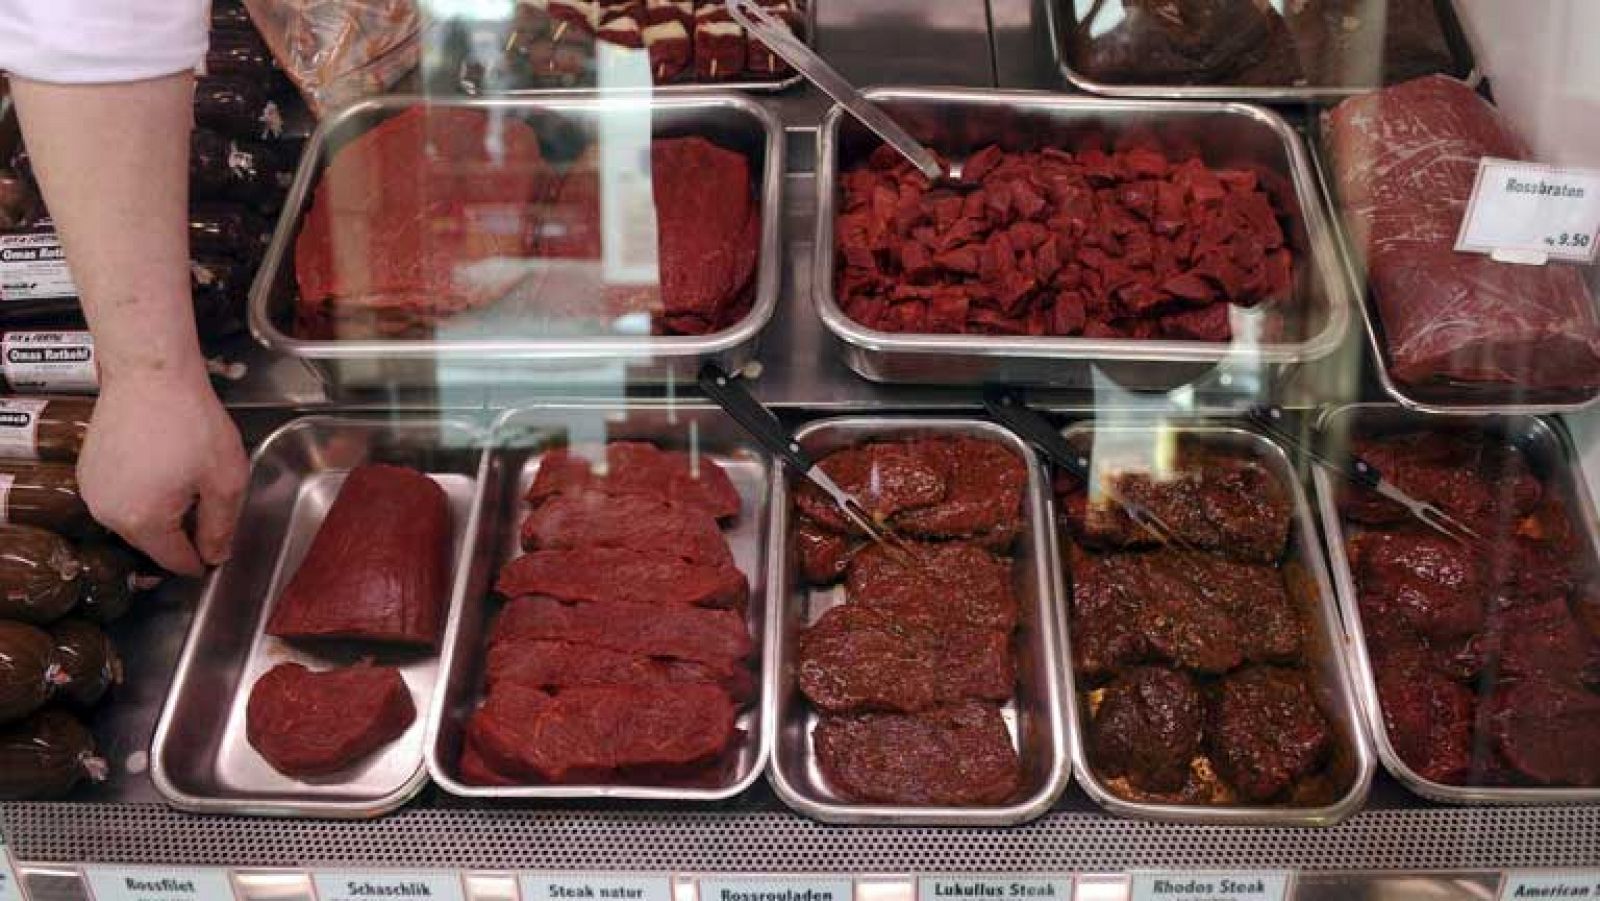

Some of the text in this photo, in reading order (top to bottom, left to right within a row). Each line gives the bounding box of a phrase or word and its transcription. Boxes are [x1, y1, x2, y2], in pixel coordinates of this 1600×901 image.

[1505, 178, 1584, 198] Rossbraten
[1558, 233, 1591, 247] 9.50
[125, 877, 195, 892] Rossfilet
[347, 881, 431, 896] Schaschlik
[549, 884, 643, 899] Steak natur
[934, 881, 1055, 897] Lukullus Steak
[1153, 878, 1265, 894] Rhodos Steak
[1514, 883, 1590, 899] American
[720, 887, 833, 901] Rossrouladen
